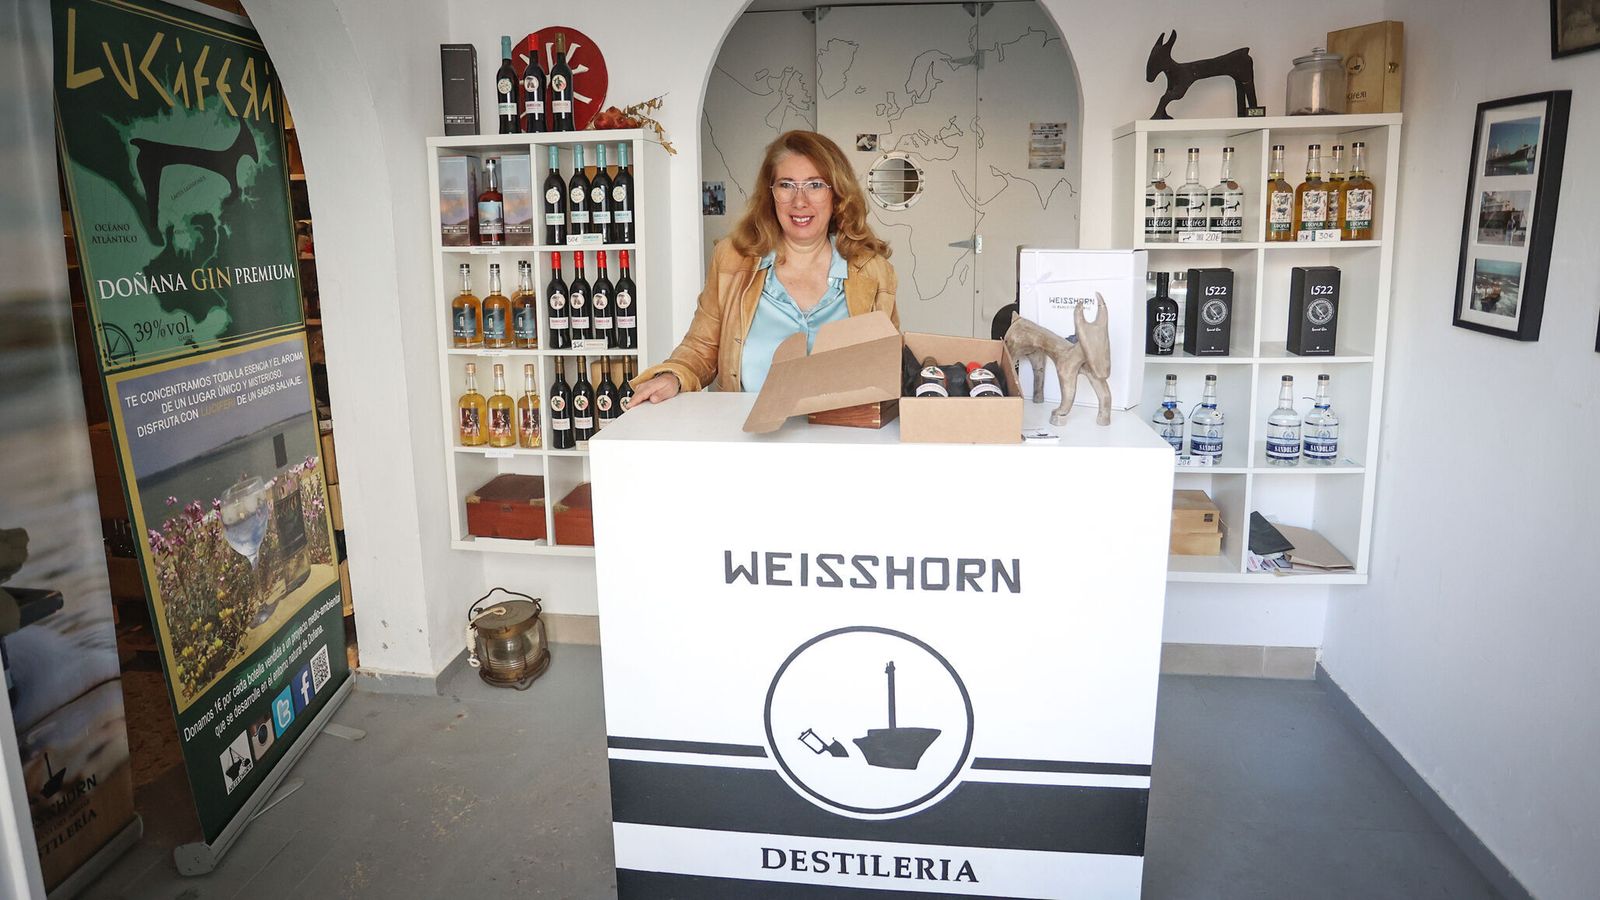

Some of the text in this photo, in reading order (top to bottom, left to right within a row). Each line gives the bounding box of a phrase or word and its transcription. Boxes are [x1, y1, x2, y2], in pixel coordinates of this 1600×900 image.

[1206, 232, 1220, 242] 20€
[1319, 231, 1334, 240] 30€
[97, 264, 295, 299] DOÑANA GIN PREMIUM
[1205, 286, 1227, 296] 1522
[1311, 285, 1333, 296] 1522
[1048, 296, 1095, 305] WEISSHORN
[1156, 312, 1176, 322] 1522
[125, 351, 303, 408] TE CONCENTRAMOS TODA LA ESENCIA Y EL AROMA
[161, 369, 283, 414] DE UN LUGAR ÚNICO Y MISTERIOSO.
[137, 415, 180, 437] DISFRUTA
[180, 409, 199, 424] CON
[236, 394, 247, 406] DE
[247, 391, 256, 402] UN
[256, 385, 275, 399] SABOR
[275, 375, 303, 392] SALVAJE.
[724, 549, 1021, 594] WEISSHORN
[183, 709, 215, 742] Donamos
[214, 697, 223, 714] 1€
[222, 691, 232, 710] por
[232, 678, 248, 698] cada
[246, 662, 265, 685] botella
[265, 646, 283, 669] vendida
[285, 636, 291, 649] un
[290, 620, 308, 646] proyecto
[214, 719, 227, 739] que
[226, 712, 234, 726] se
[233, 687, 261, 718] desarrolle
[260, 680, 268, 693] en
[267, 672, 273, 687] el
[273, 659, 289, 681] entorno
[288, 642, 302, 665] natural
[302, 638, 308, 651] de
[760, 847, 979, 883] DESTILERIA
